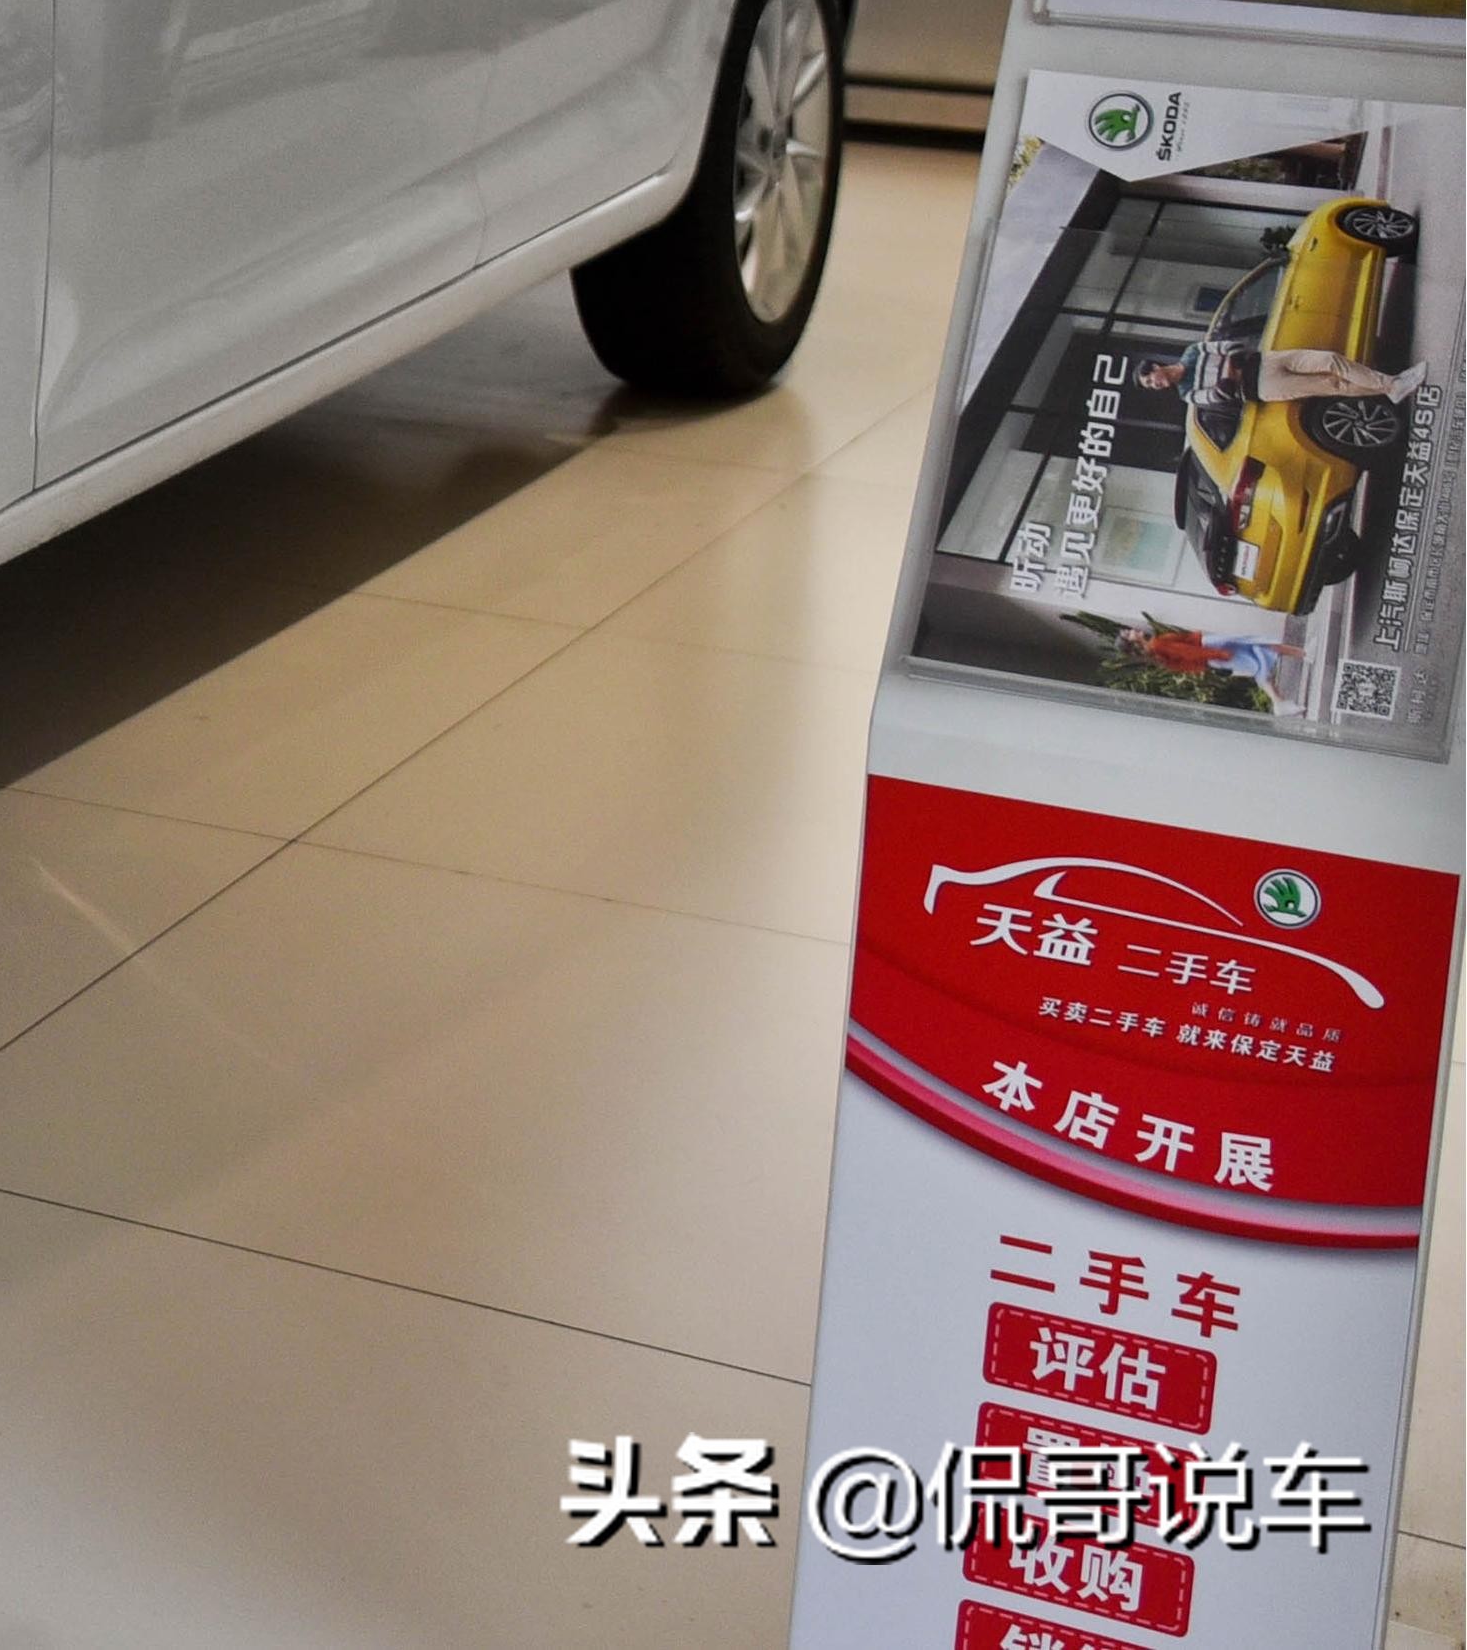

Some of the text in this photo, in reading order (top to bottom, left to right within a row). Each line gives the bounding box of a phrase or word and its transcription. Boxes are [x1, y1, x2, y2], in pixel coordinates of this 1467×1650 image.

[1054, 353, 1129, 598] 遇见更好的自己
[1010, 521, 1052, 593] 昕动
[970, 902, 1257, 995] 天益 二手车
[1038, 996, 1336, 1073] 买卖二手车 就来保定天益
[1190, 1001, 1344, 1043] 诚信铸就品质
[982, 1059, 1275, 1192] 本店开展
[989, 1235, 1241, 1338] 二手车
[1029, 1326, 1167, 1411] 评估
